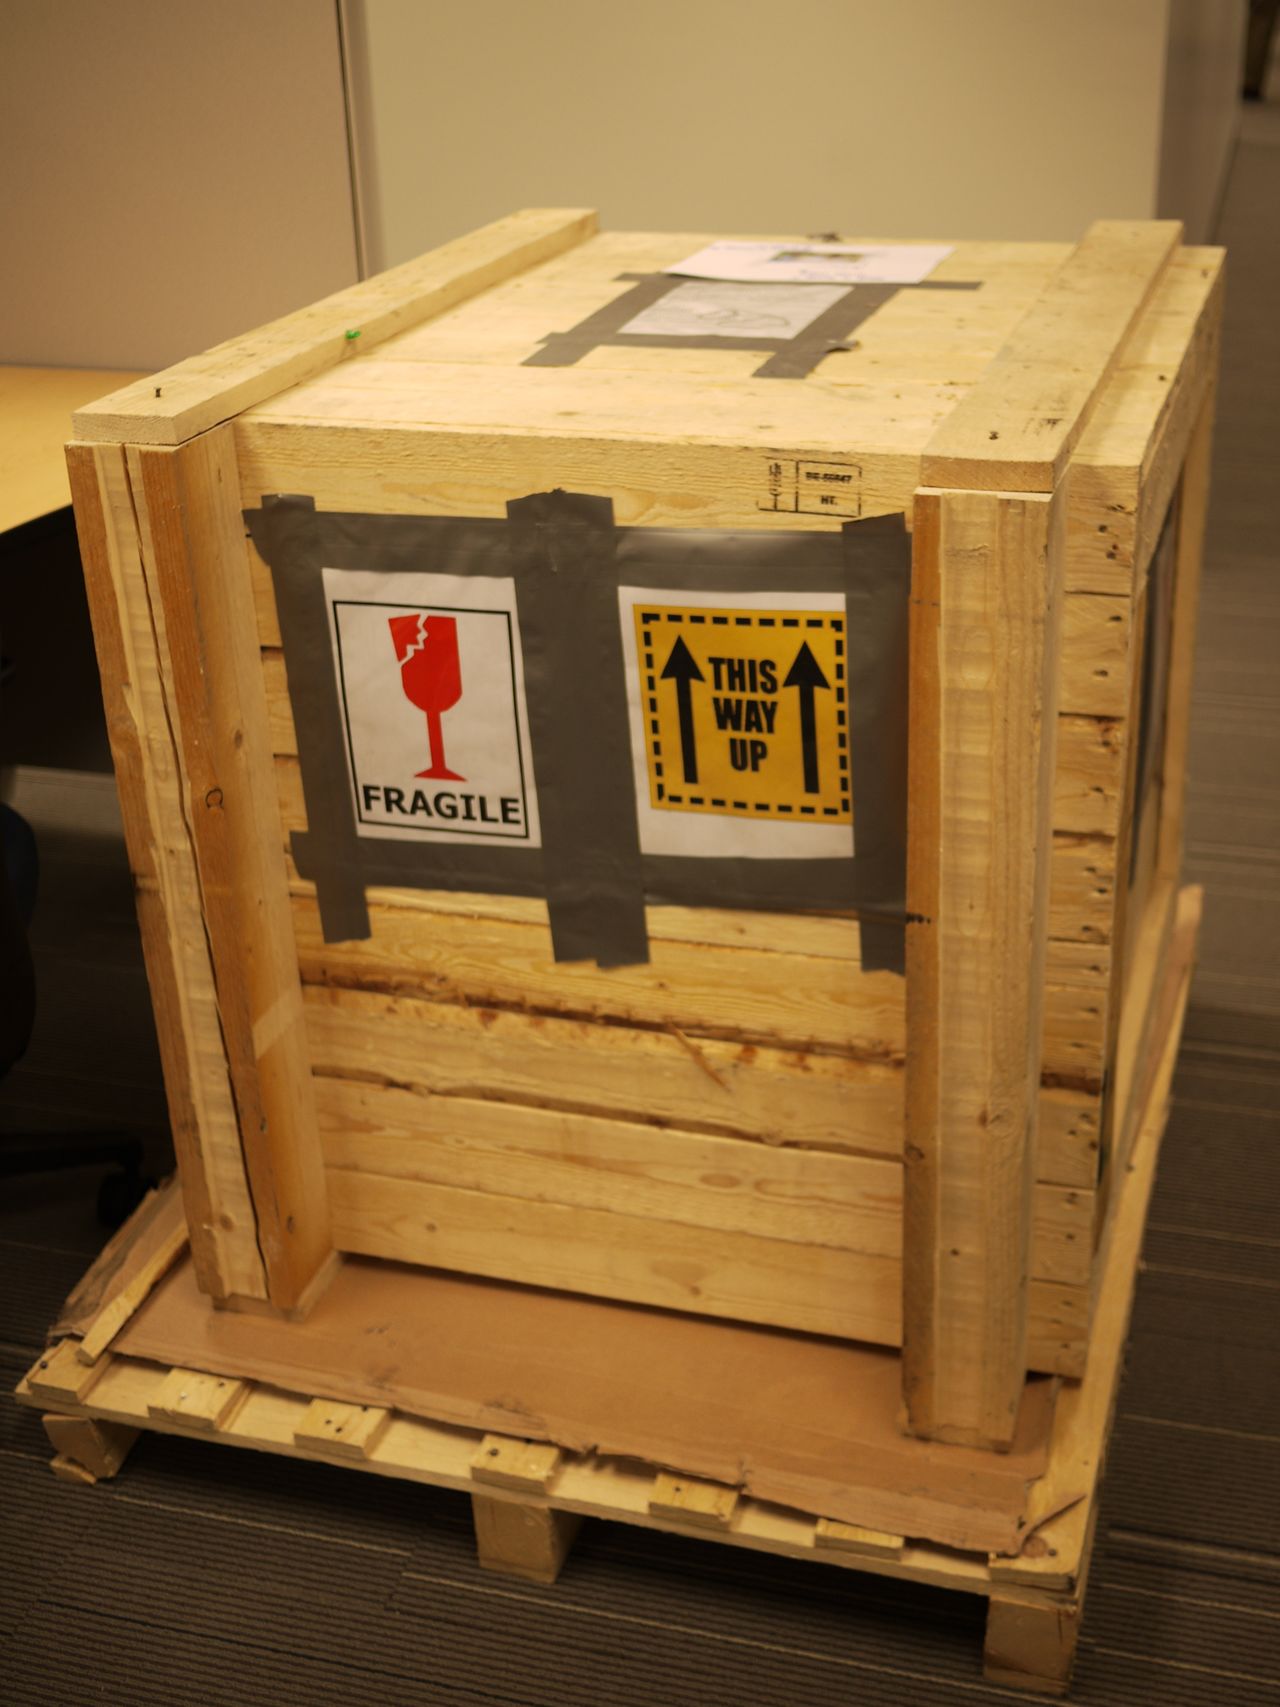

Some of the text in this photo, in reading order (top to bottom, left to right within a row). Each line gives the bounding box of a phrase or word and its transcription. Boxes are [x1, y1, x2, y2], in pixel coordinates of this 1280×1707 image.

[707, 656, 779, 695] THIS
[712, 696, 779, 735] WAY
[729, 736, 768, 773] UP
[362, 784, 522, 825] FRAGILE
